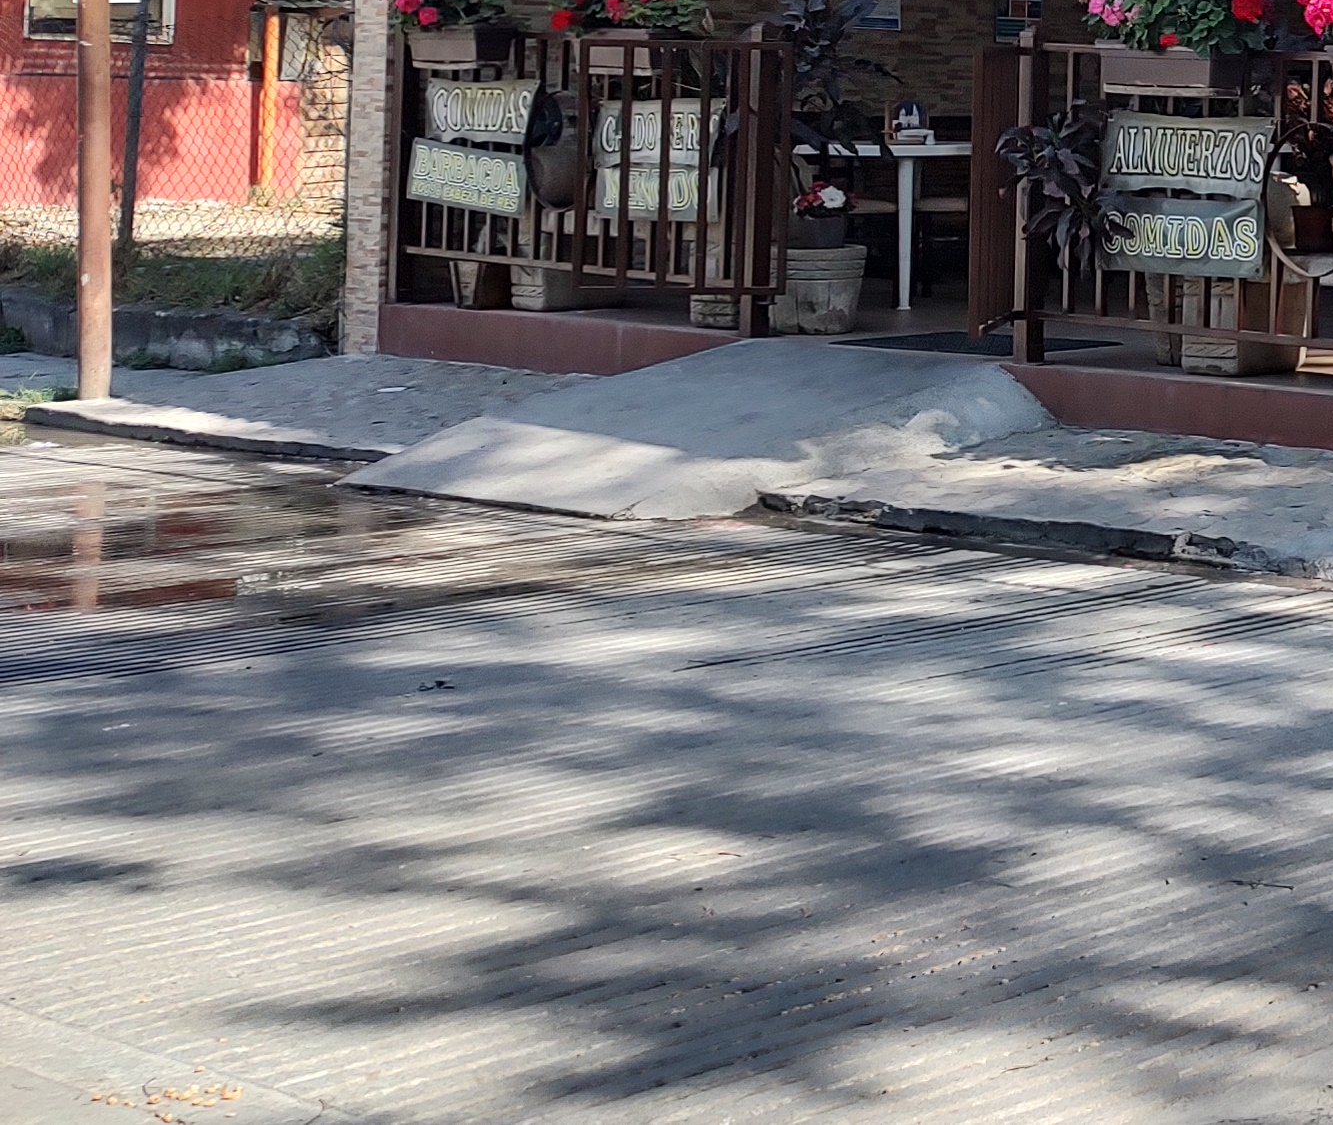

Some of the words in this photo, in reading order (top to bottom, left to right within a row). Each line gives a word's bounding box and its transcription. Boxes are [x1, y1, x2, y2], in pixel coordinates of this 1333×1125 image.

[432, 86, 532, 135] COMIDAS
[412, 144, 520, 197] BARBACOA
[1110, 126, 1266, 183] ALMUERZOS
[1102, 211, 1259, 261] COMIDAS
